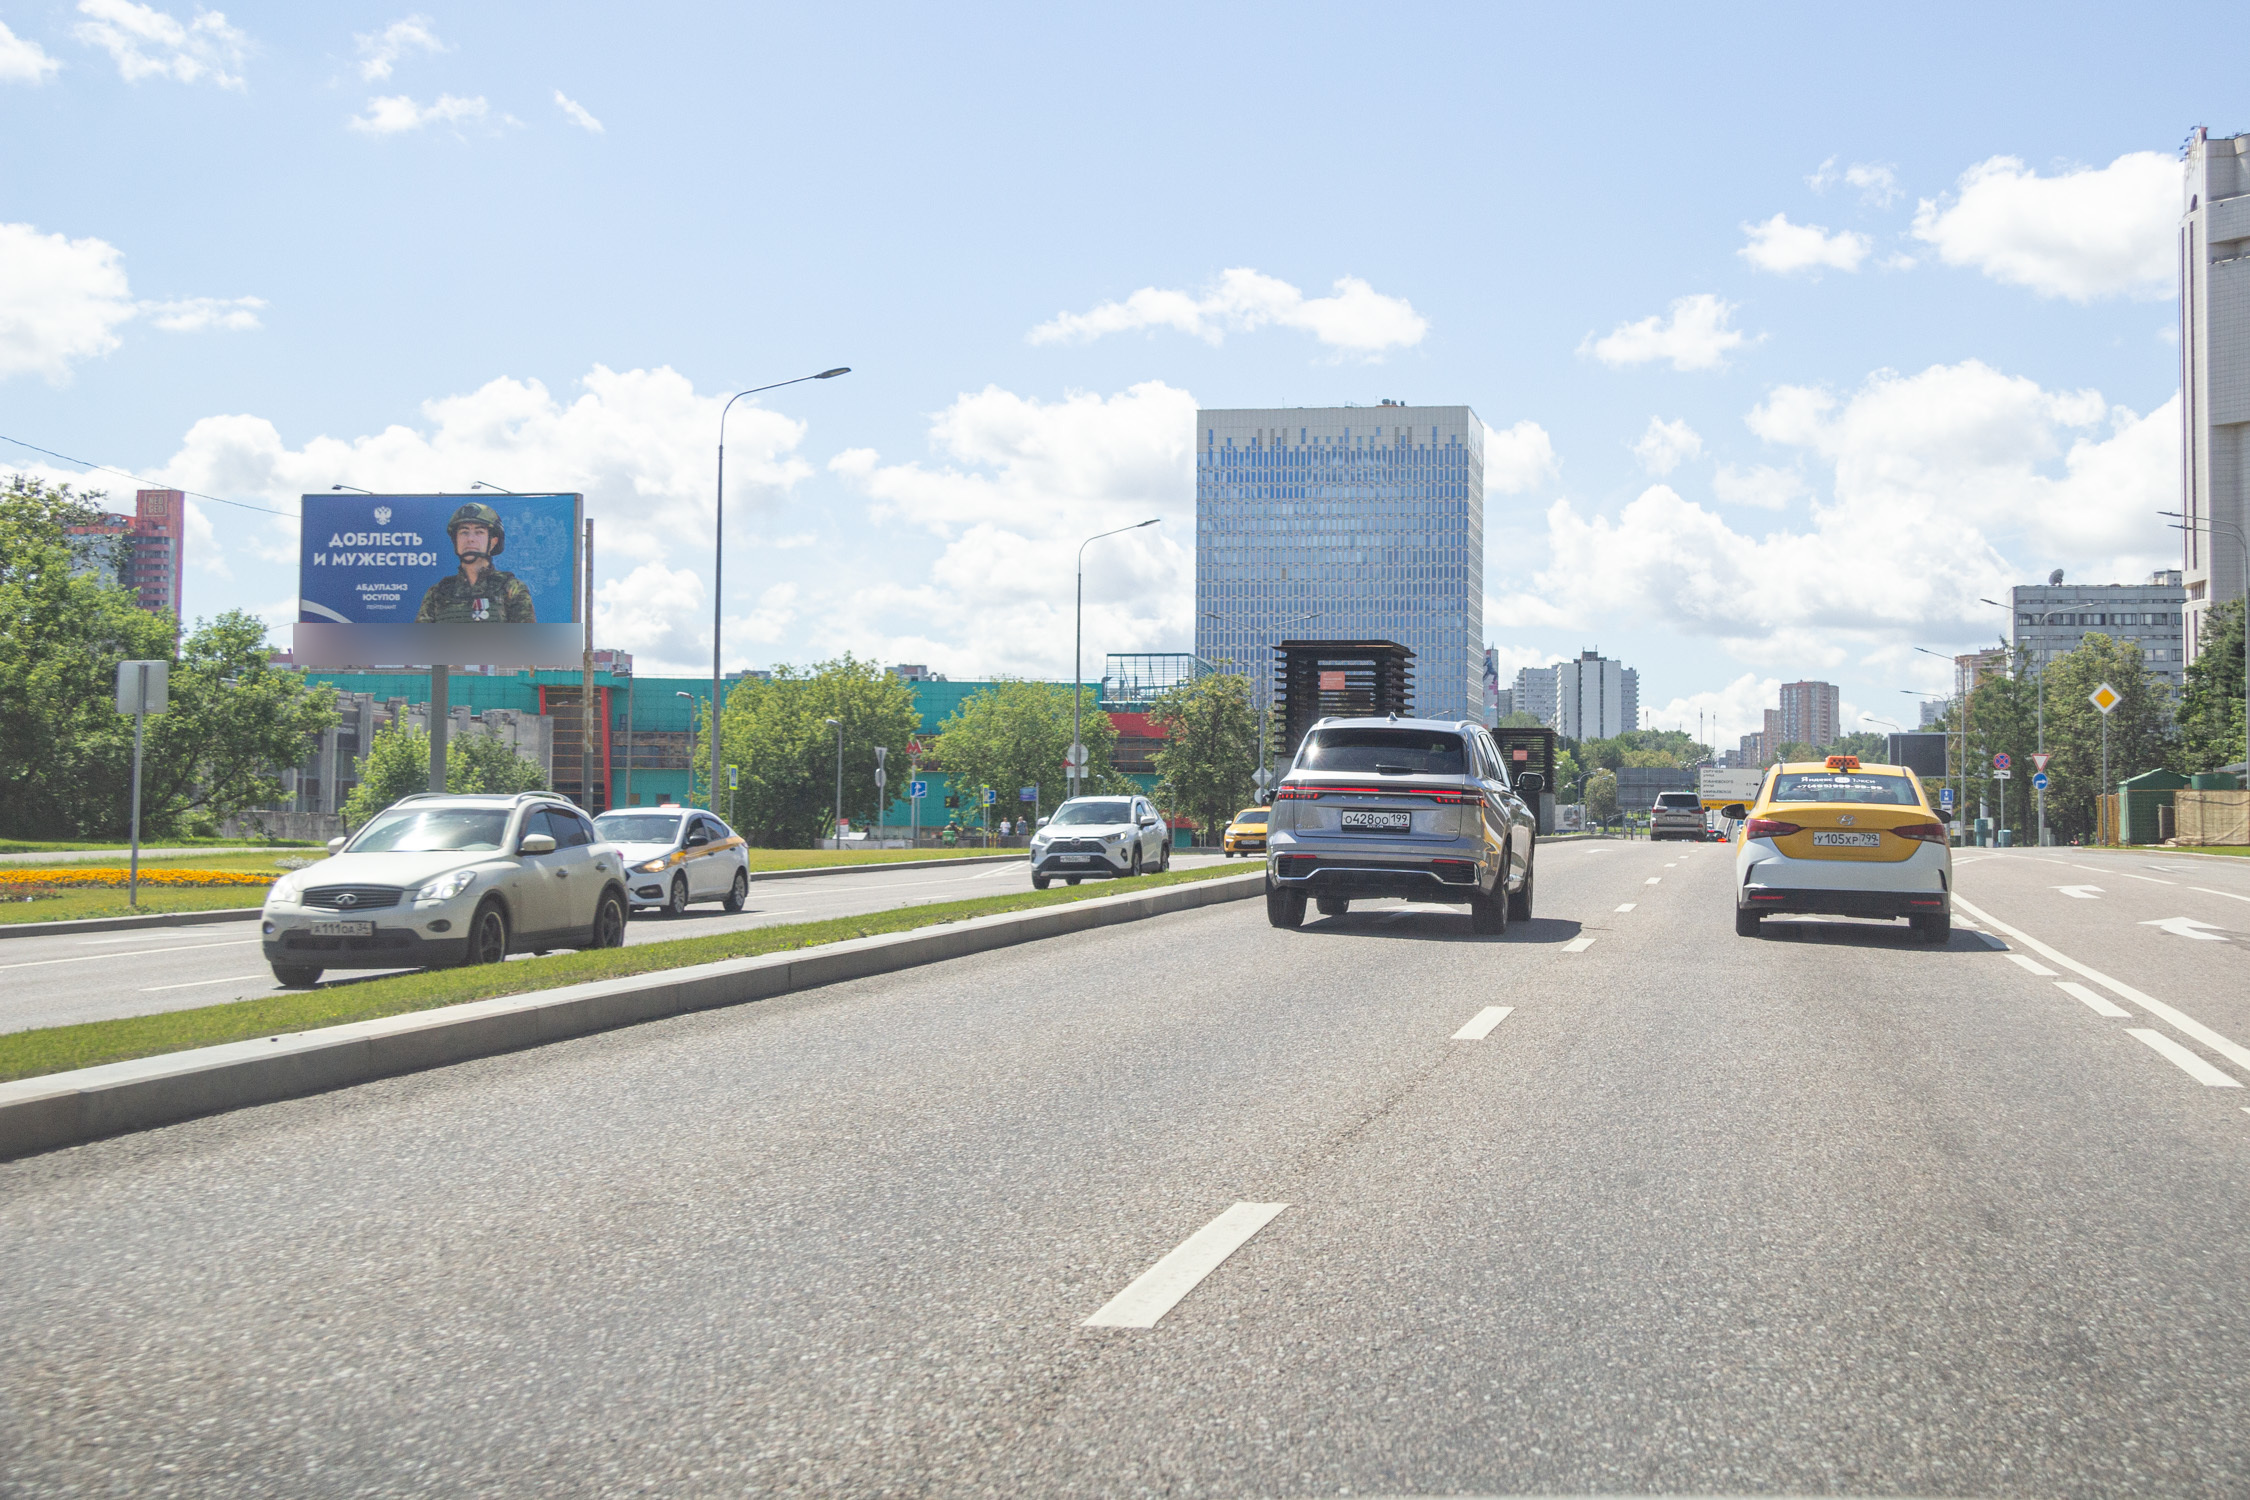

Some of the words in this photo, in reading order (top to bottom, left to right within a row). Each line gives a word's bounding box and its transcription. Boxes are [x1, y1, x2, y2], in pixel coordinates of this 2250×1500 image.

[328, 532, 423, 548] ДОБЛЕСТЬ
[313, 552, 327, 566] И
[331, 552, 438, 567] МУЖЕСТВО!
[355, 583, 408, 592] АБДУЛАЗИЗ
[362, 593, 401, 601] ЮСУПОВ
[1391, 814, 1408, 823] 199
[1860, 833, 1878, 843] 799
